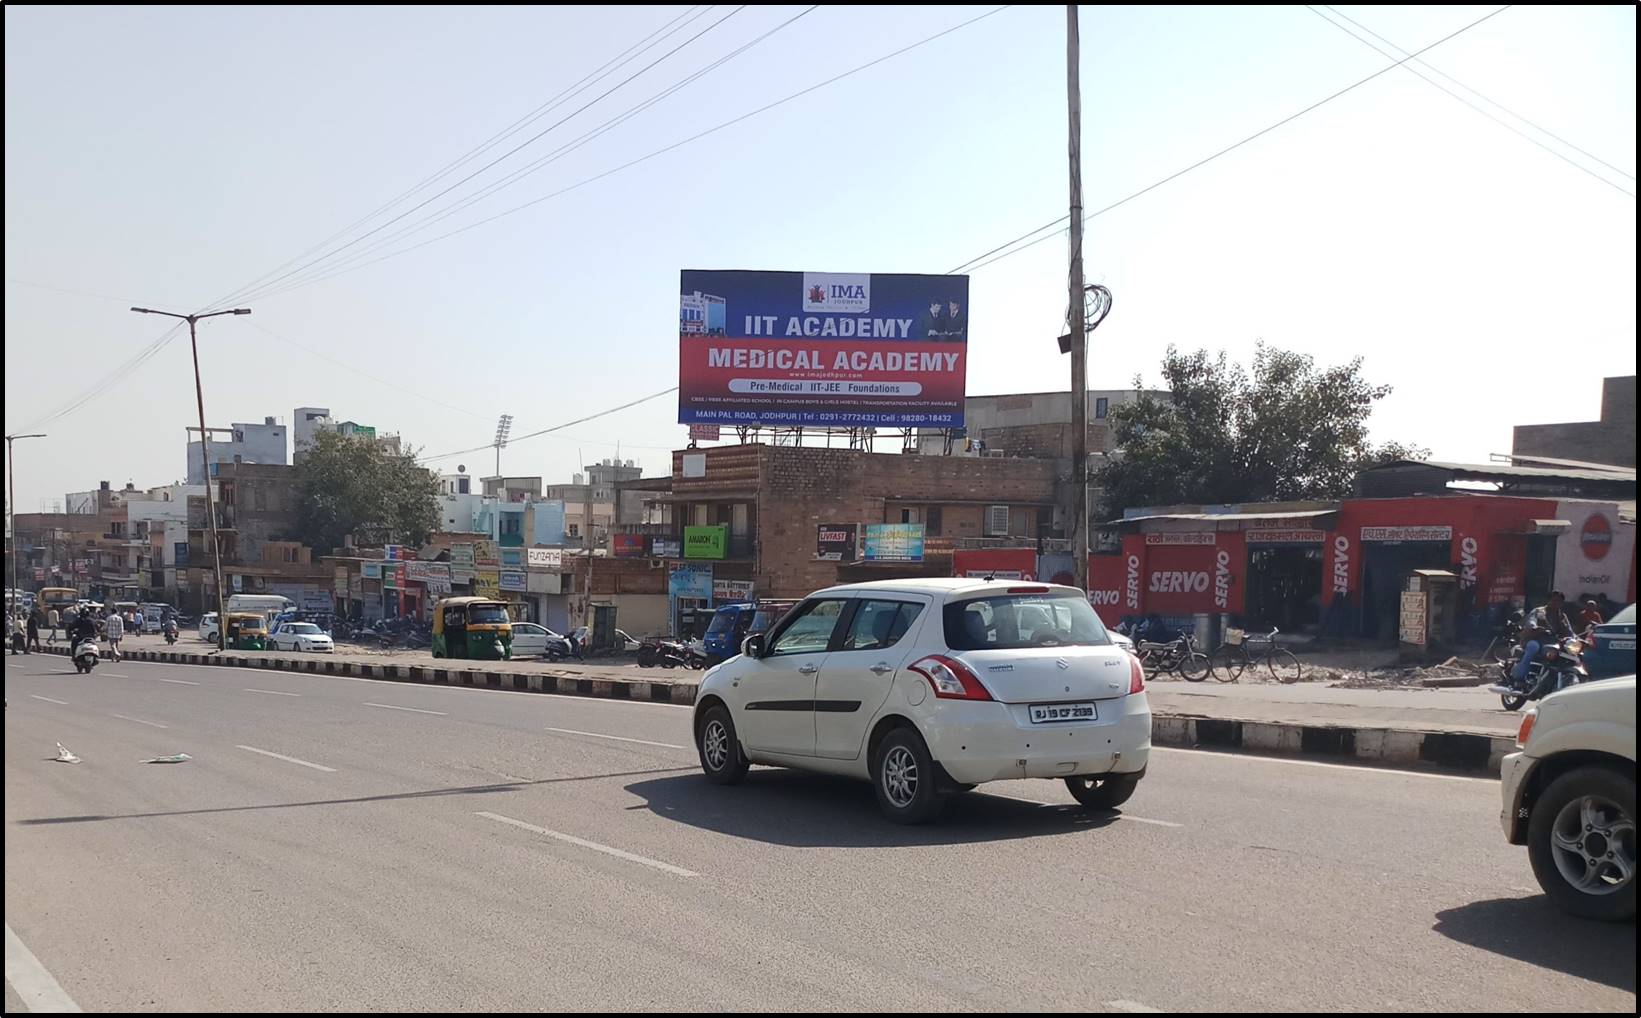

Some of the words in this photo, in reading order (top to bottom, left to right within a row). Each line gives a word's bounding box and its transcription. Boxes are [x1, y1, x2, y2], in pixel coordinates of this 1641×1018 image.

[831, 285, 866, 299] IMA
[744, 315, 778, 335] IIT
[785, 316, 913, 338] ACADEMY
[708, 347, 825, 370] MEDICAL
[832, 350, 959, 372] ACADEMY
[750, 381, 803, 392] Pre-Medical
[810, 382, 841, 392] IIT-JEE
[848, 383, 900, 393] Foundations
[695, 410, 717, 418] MAIN
[734, 411, 758, 420] ROAD,
[759, 412, 797, 420] JODHPUR
[803, 412, 814, 420] Tel
[819, 413, 875, 421] 0291-2772432
[901, 414, 952, 422] 98280-18432
[688, 535, 711, 544] AMARON
[820, 532, 845, 540] LIVFAST
[1126, 554, 1140, 609] SERVO
[1149, 571, 1210, 593] SERVO
[1215, 550, 1230, 609] SERVO
[1088, 590, 1120, 605] ERVO
[1034, 710, 1047, 720] RJ
[1048, 709, 1058, 718] 19
[1059, 708, 1071, 718] CF
